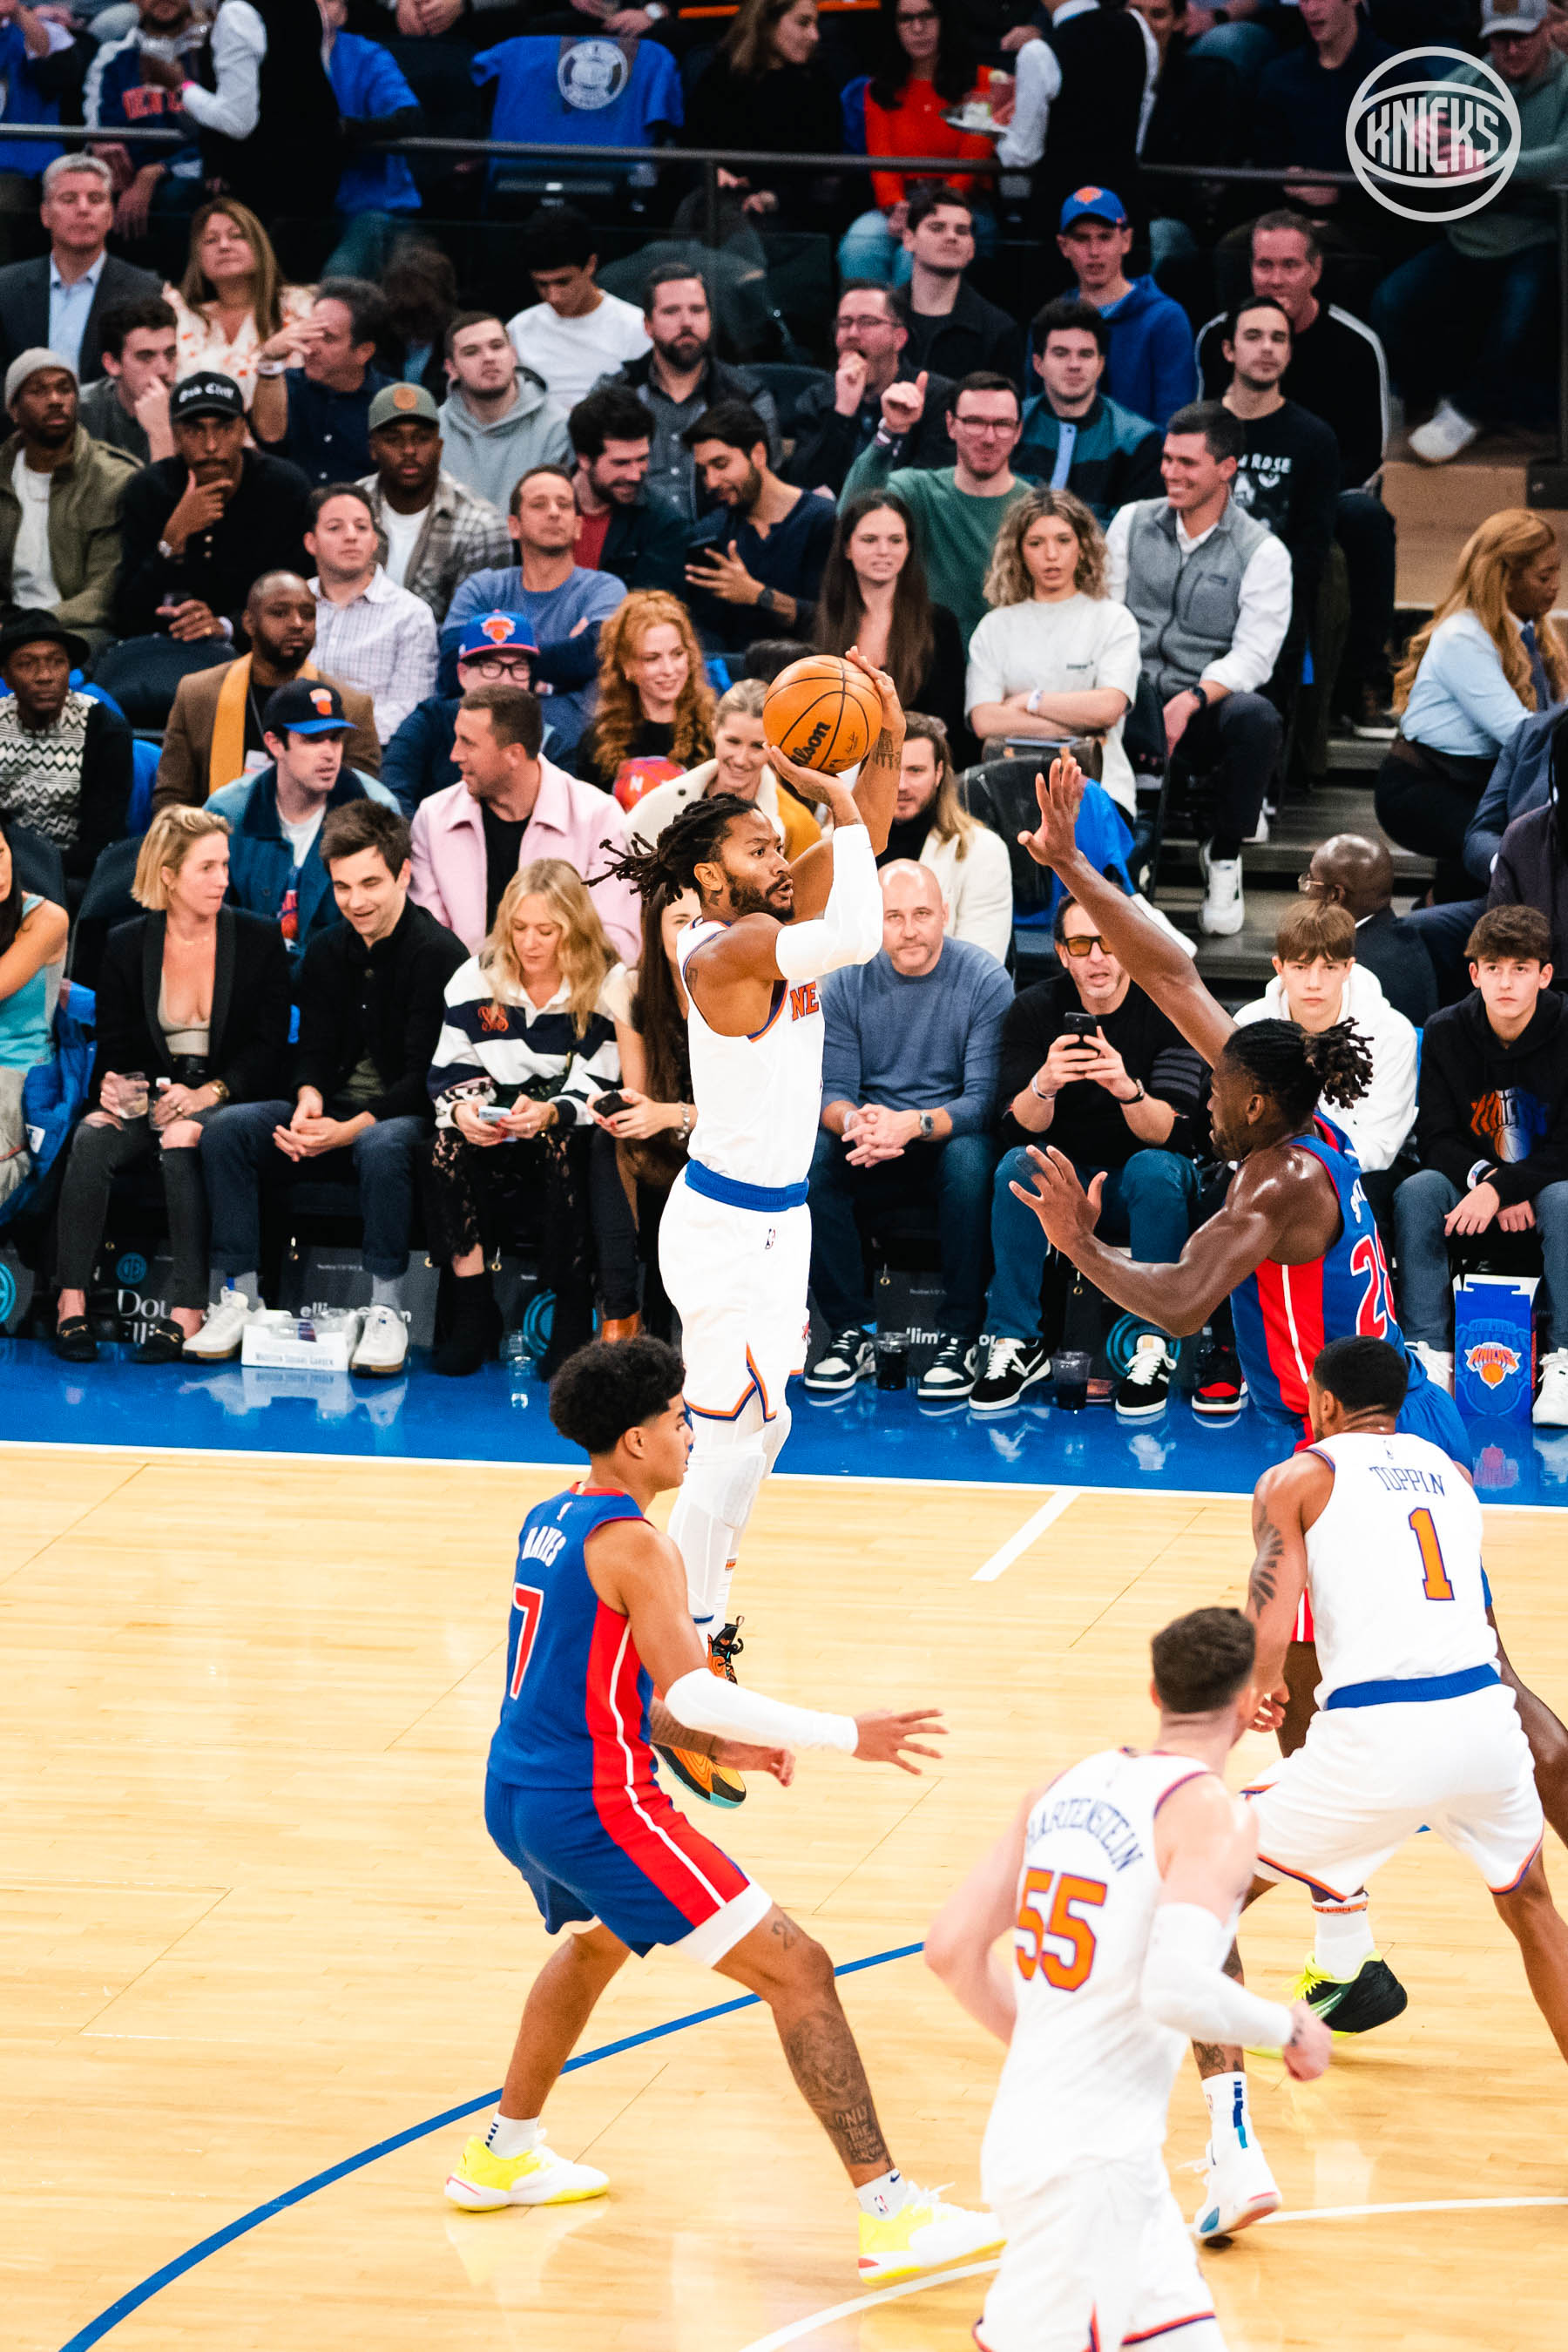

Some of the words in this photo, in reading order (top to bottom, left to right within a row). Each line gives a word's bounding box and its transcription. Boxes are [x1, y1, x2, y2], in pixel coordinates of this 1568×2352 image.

[1251, 453, 1291, 473] ROSE
[790, 721, 831, 765] ilson
[1469, 1348, 1517, 1367] KNICKS
[1369, 1466, 1445, 1497] TOPPIN
[1408, 1507, 1456, 1601] 1
[510, 1582, 544, 1700] 7
[1015, 1867, 1107, 1992] 55
